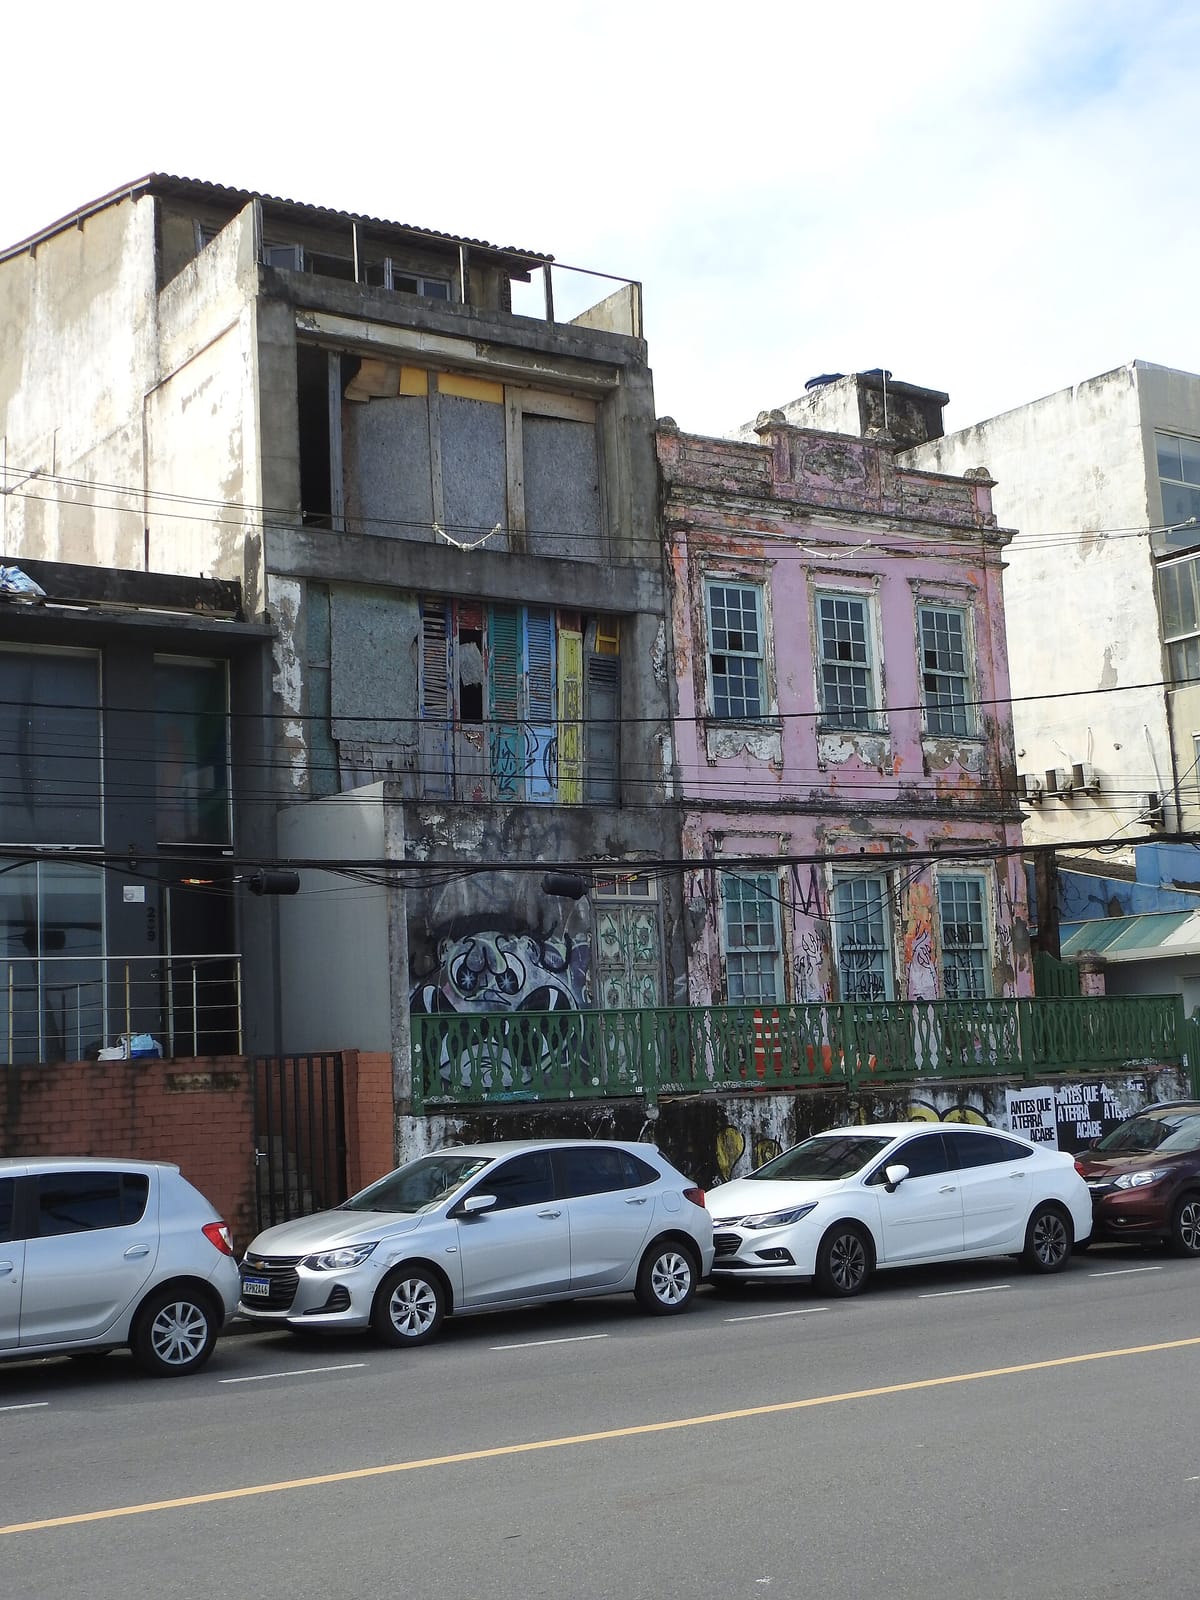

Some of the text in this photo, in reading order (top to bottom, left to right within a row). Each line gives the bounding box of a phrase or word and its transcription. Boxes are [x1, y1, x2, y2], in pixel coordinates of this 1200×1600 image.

[1083, 1085, 1100, 1106] QUE
[1010, 1097, 1052, 1115] ANTES QUE
[1057, 1104, 1091, 1122] A TERRA
[1103, 1102, 1111, 1119] A
[1011, 1114, 1043, 1129] A TERRA
[1076, 1120, 1103, 1138] ACABE
[1030, 1127, 1054, 1142] ACABE
